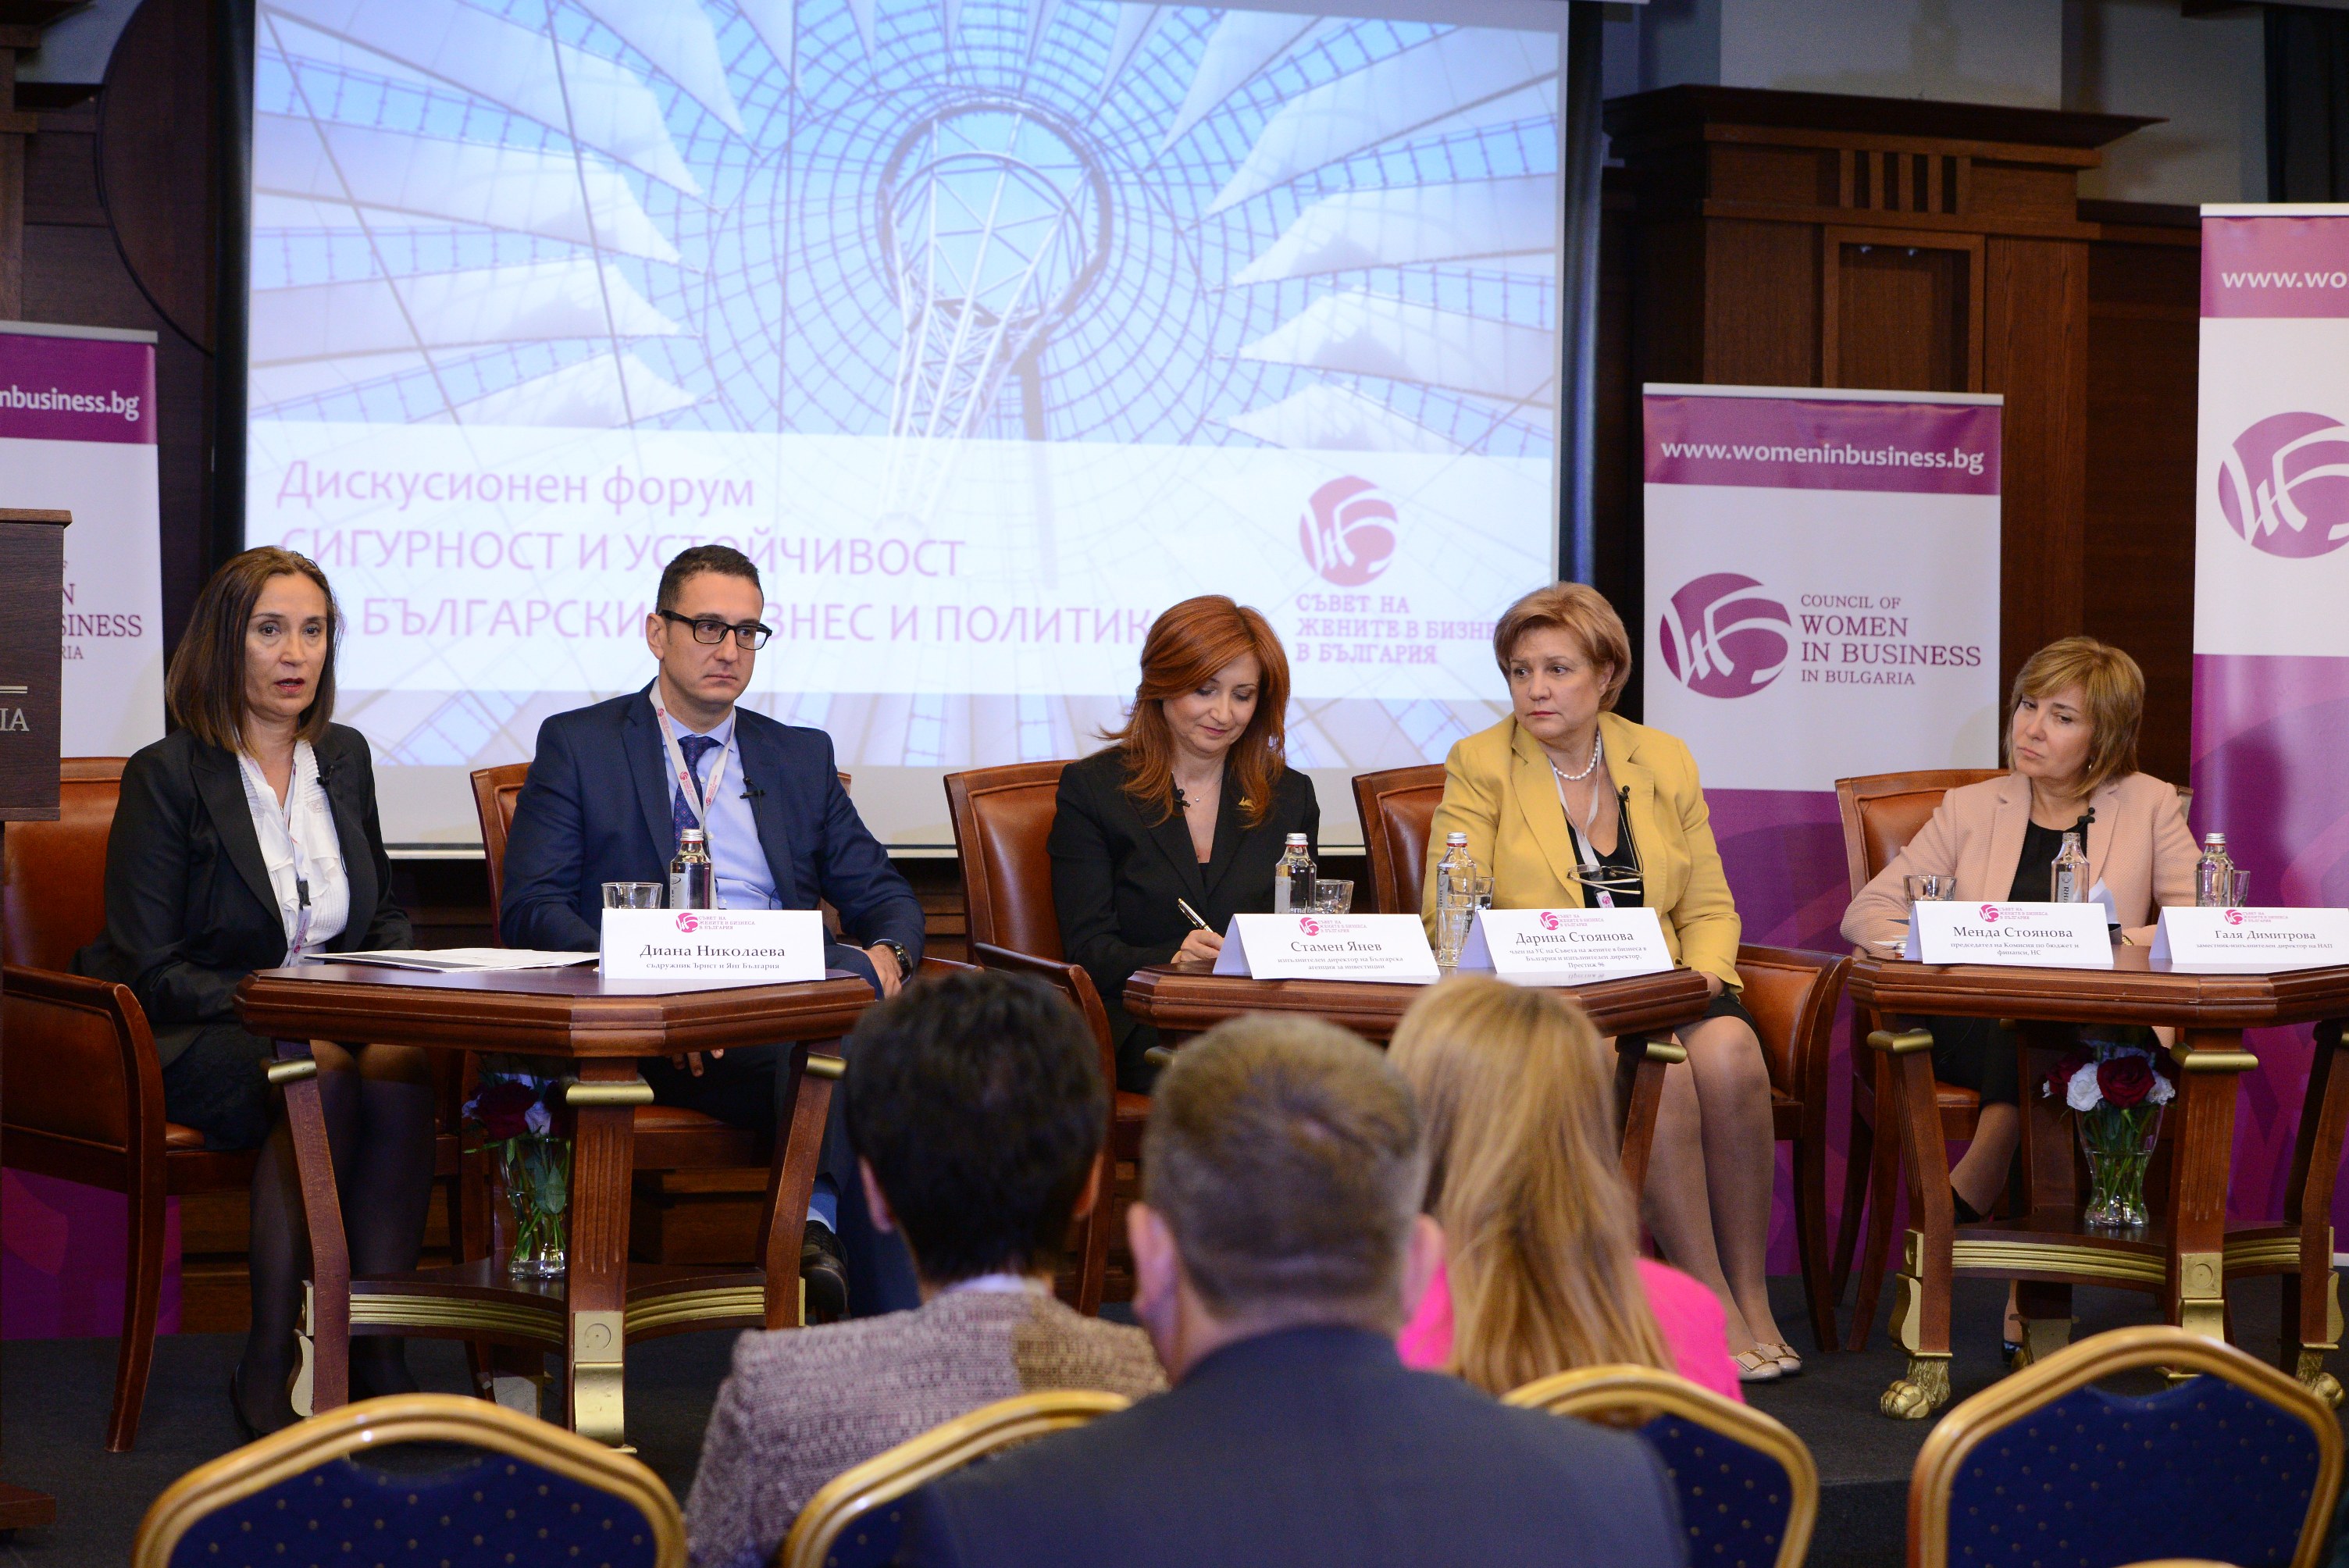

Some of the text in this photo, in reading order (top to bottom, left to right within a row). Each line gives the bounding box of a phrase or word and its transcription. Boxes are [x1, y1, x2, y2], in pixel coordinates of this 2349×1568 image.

[2221, 270, 2349, 289] www.wo
[1660, 442, 1985, 476] www.womeninbusiness.bg
[276, 459, 754, 517] Дискусионен форум
[577, 533, 608, 571] И
[624, 526, 966, 578] УСЙЧИВОСТ
[1295, 593, 1411, 615] СЪВЕТ НА
[1799, 594, 1902, 611] COUNCIL OF
[362, 597, 648, 640] БЪЛГАРСКИ
[890, 604, 919, 643] И
[936, 604, 1152, 646] ПОЛИТИК
[1295, 618, 1400, 639] ЖЕНИТЕ
[1405, 620, 1420, 640] В
[1798, 614, 1909, 638] WOMEN
[1295, 643, 1438, 665] В БЪЛГАРИЯ
[1800, 641, 1982, 667] IN BUSINESS
[1800, 669, 1916, 686] IN BULGARIA
[1516, 932, 1634, 946] Дарина Стоянова
[1952, 926, 2073, 939] Менда Стоянова
[2215, 930, 2317, 942] Галя Димитрова
[640, 944, 786, 959] Диана Николаева
[1290, 941, 1382, 953] Стамен Янев
[646, 963, 691, 971] съдружник
